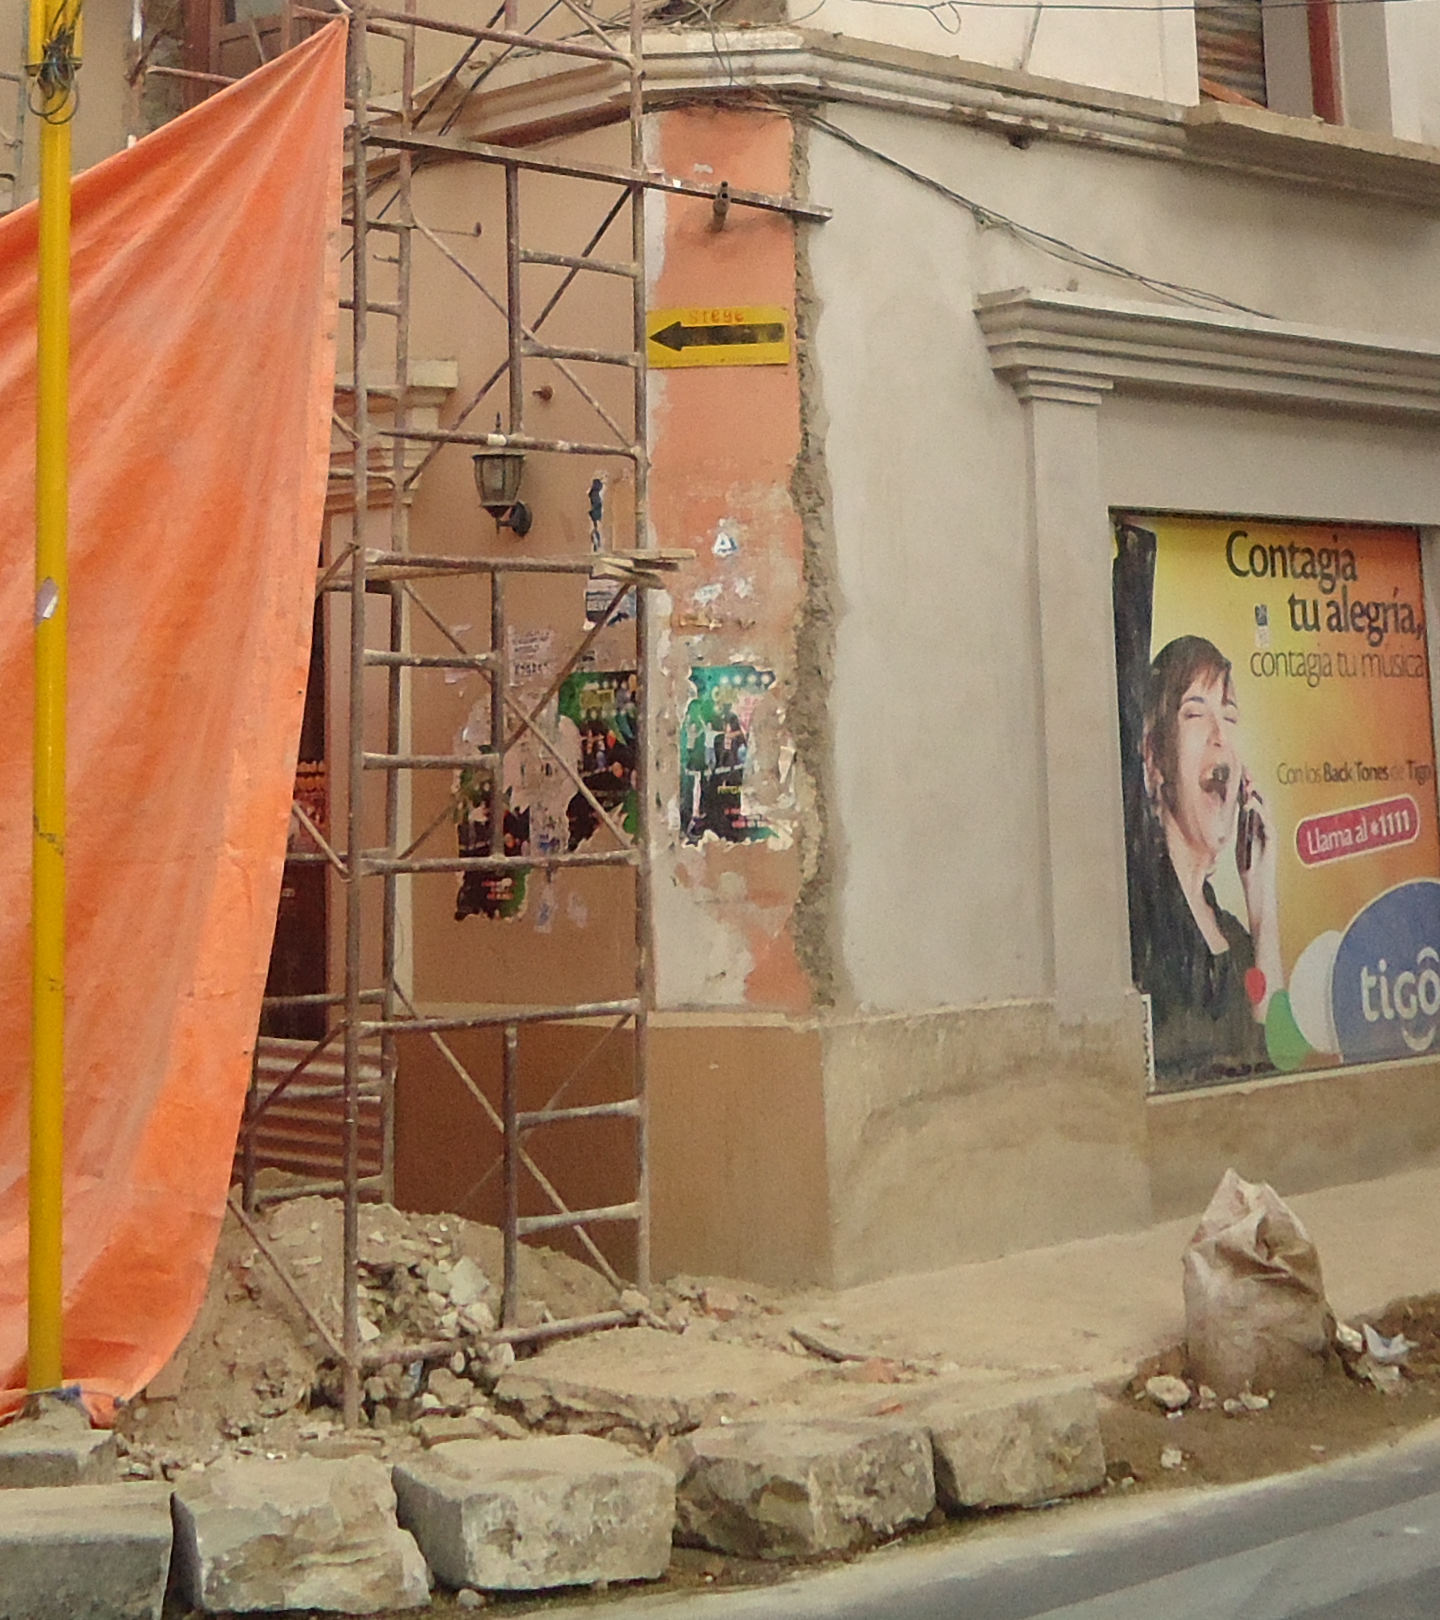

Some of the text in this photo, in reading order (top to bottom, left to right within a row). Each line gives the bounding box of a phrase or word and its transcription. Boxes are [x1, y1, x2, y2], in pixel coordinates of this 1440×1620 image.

[1226, 530, 1357, 594] Contagia
[1288, 593, 1320, 632] tu
[1250, 643, 1333, 687] contagia
[1337, 651, 1356, 677] tu
[1277, 762, 1303, 785] Con
[1323, 761, 1353, 782] Back
[1355, 760, 1389, 781] Tones
[1307, 827, 1352, 855] Llama
[1355, 816, 1368, 843] al
